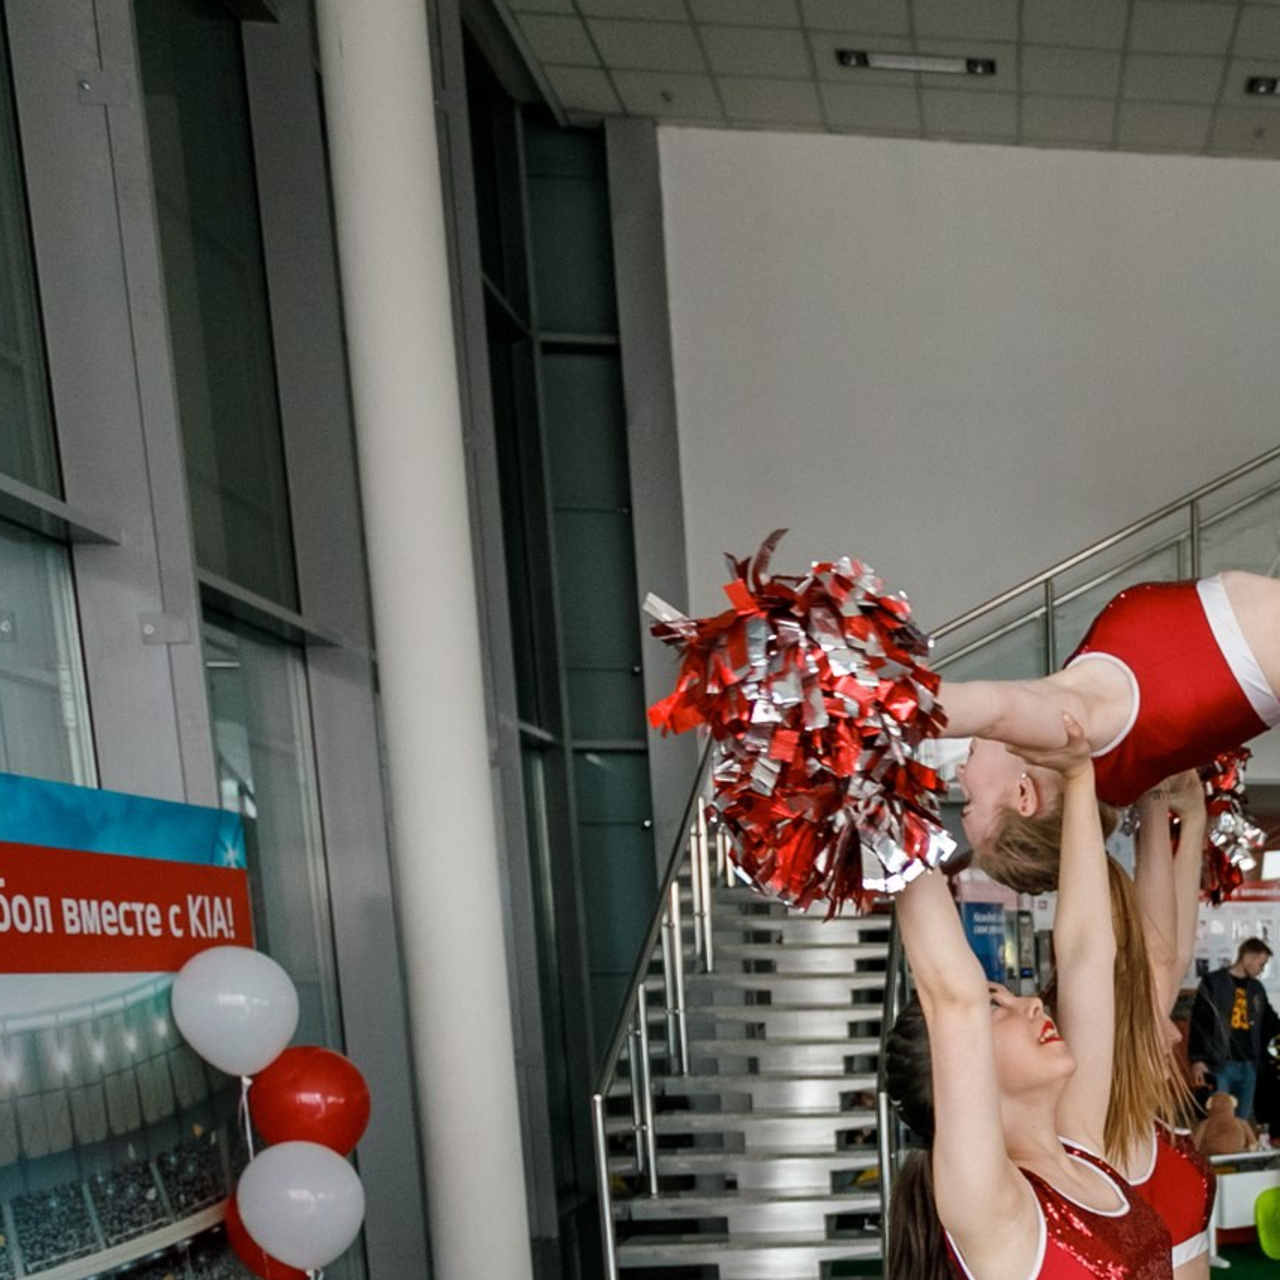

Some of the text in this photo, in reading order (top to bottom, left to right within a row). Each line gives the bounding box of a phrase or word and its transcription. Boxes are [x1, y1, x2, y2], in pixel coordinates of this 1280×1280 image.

[61, 897, 162, 937] вместе
[168, 904, 184, 938] с
[187, 894, 236, 939] KIA!
